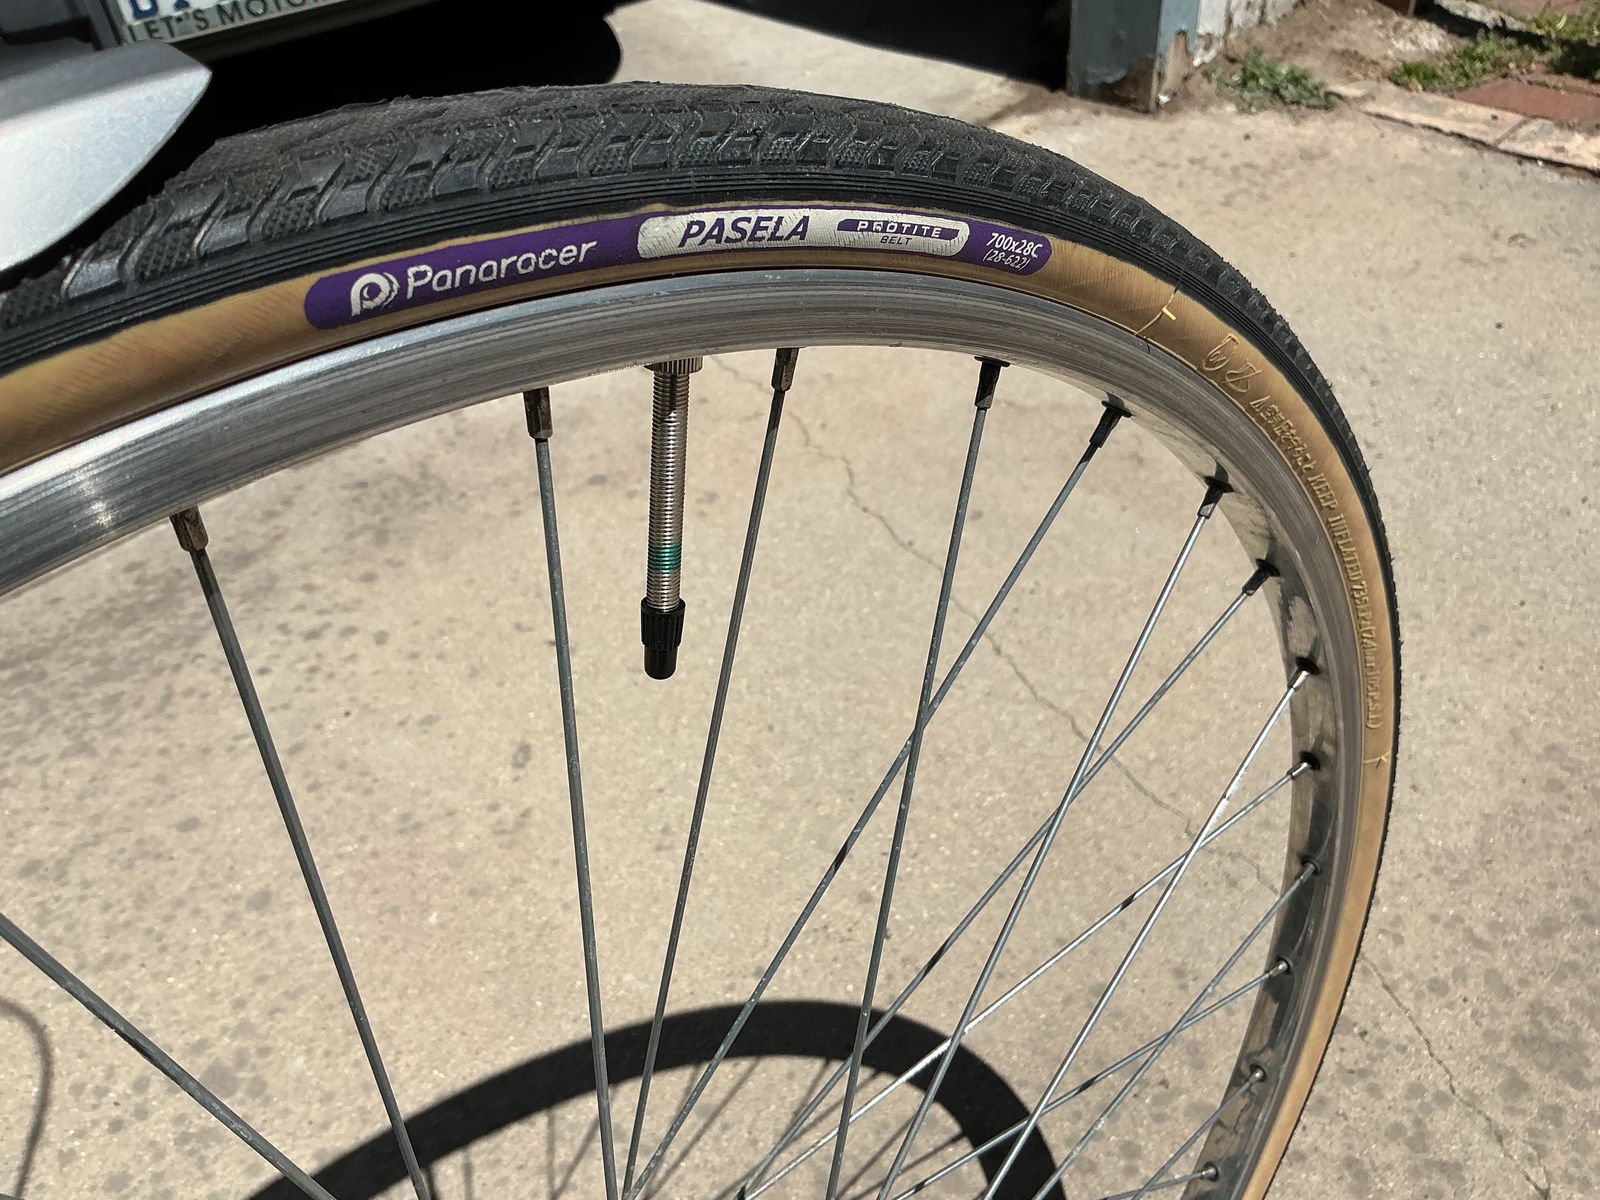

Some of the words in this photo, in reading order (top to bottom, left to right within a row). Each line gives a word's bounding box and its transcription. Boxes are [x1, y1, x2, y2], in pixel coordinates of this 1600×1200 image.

[678, 215, 810, 247] PASELA
[857, 220, 942, 238] PROTITE
[880, 235, 912, 245] BELT
[986, 232, 1043, 258] 700x28C
[406, 240, 597, 299] Panaracer
[982, 248, 1031, 271] (28-622)
[1308, 472, 1337, 509] KEEP
